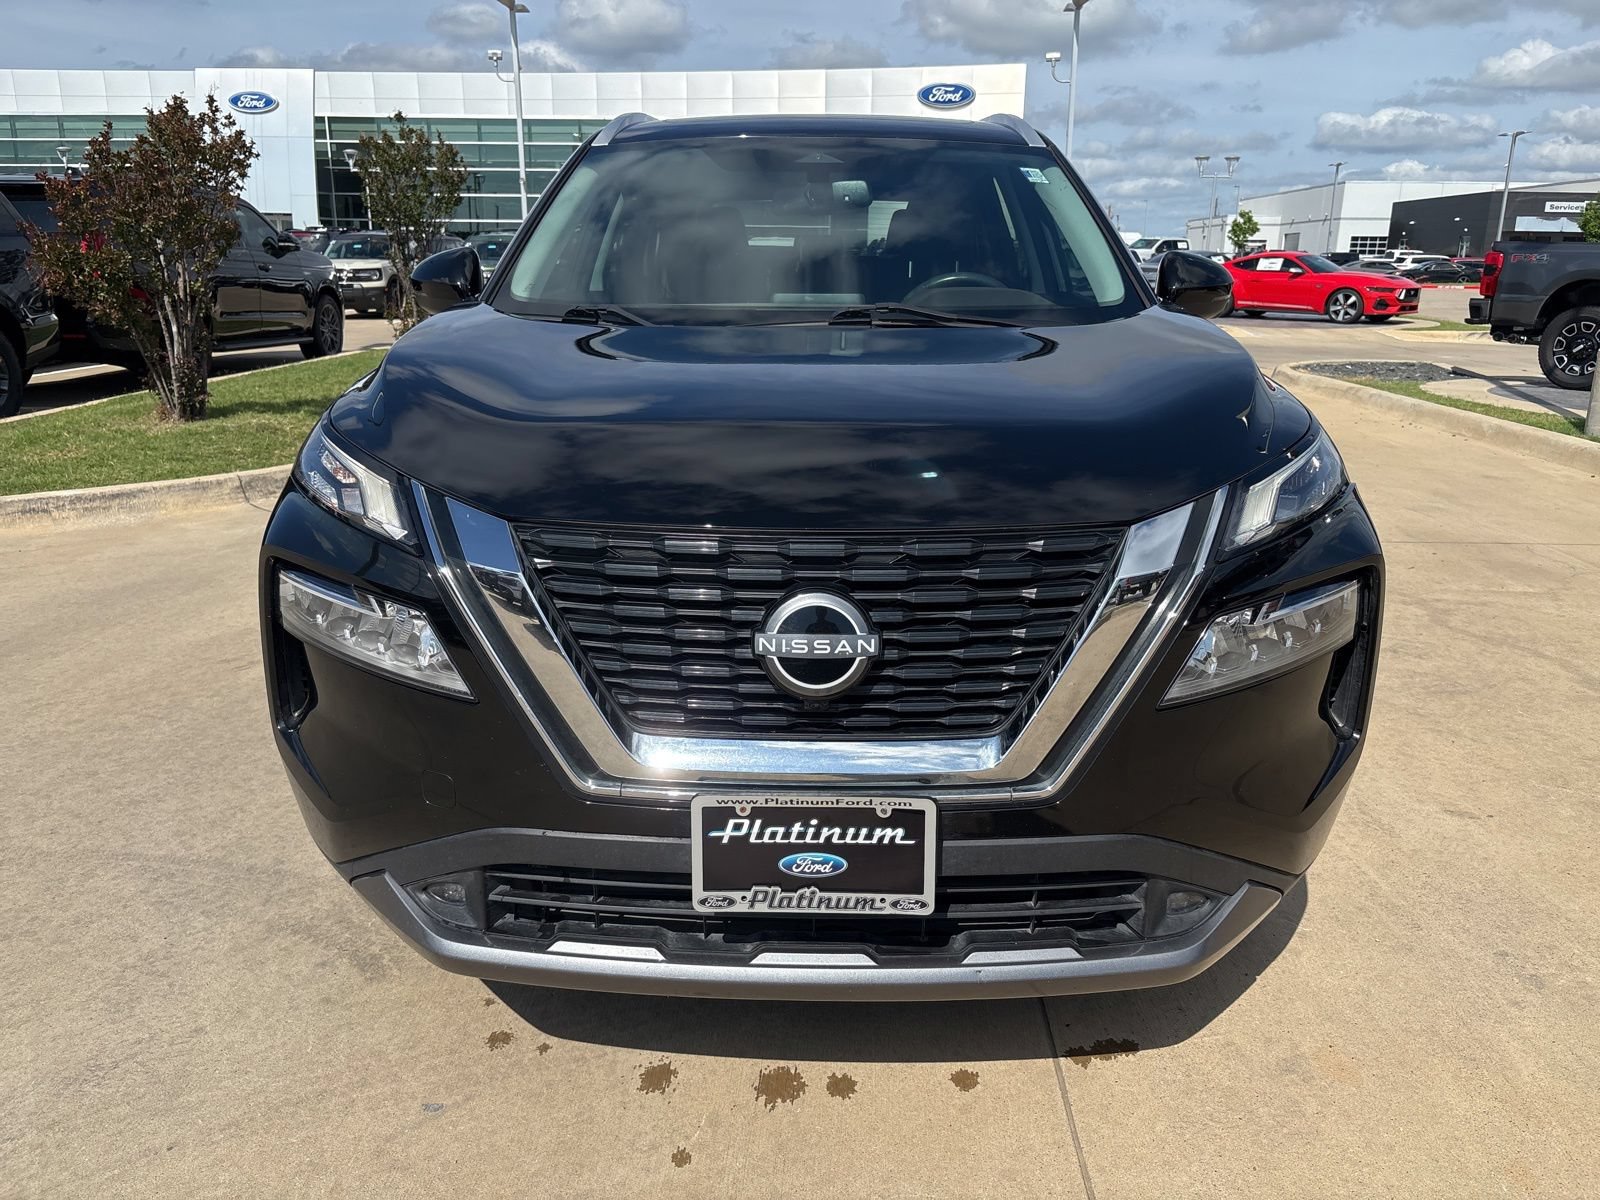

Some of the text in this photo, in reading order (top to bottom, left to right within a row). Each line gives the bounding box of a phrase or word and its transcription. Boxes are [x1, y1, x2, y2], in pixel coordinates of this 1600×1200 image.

[237, 94, 266, 108] Ford
[928, 86, 963, 102] Ford
[1510, 253, 1549, 263] FX4
[758, 637, 875, 654] NISSAN
[716, 797, 913, 807] www.PlatinumFord.com
[707, 818, 916, 844] Platinum
[792, 856, 833, 873] Ford
[704, 896, 730, 908] Ford
[746, 886, 886, 912] Platinum
[896, 898, 922, 910] Ford
